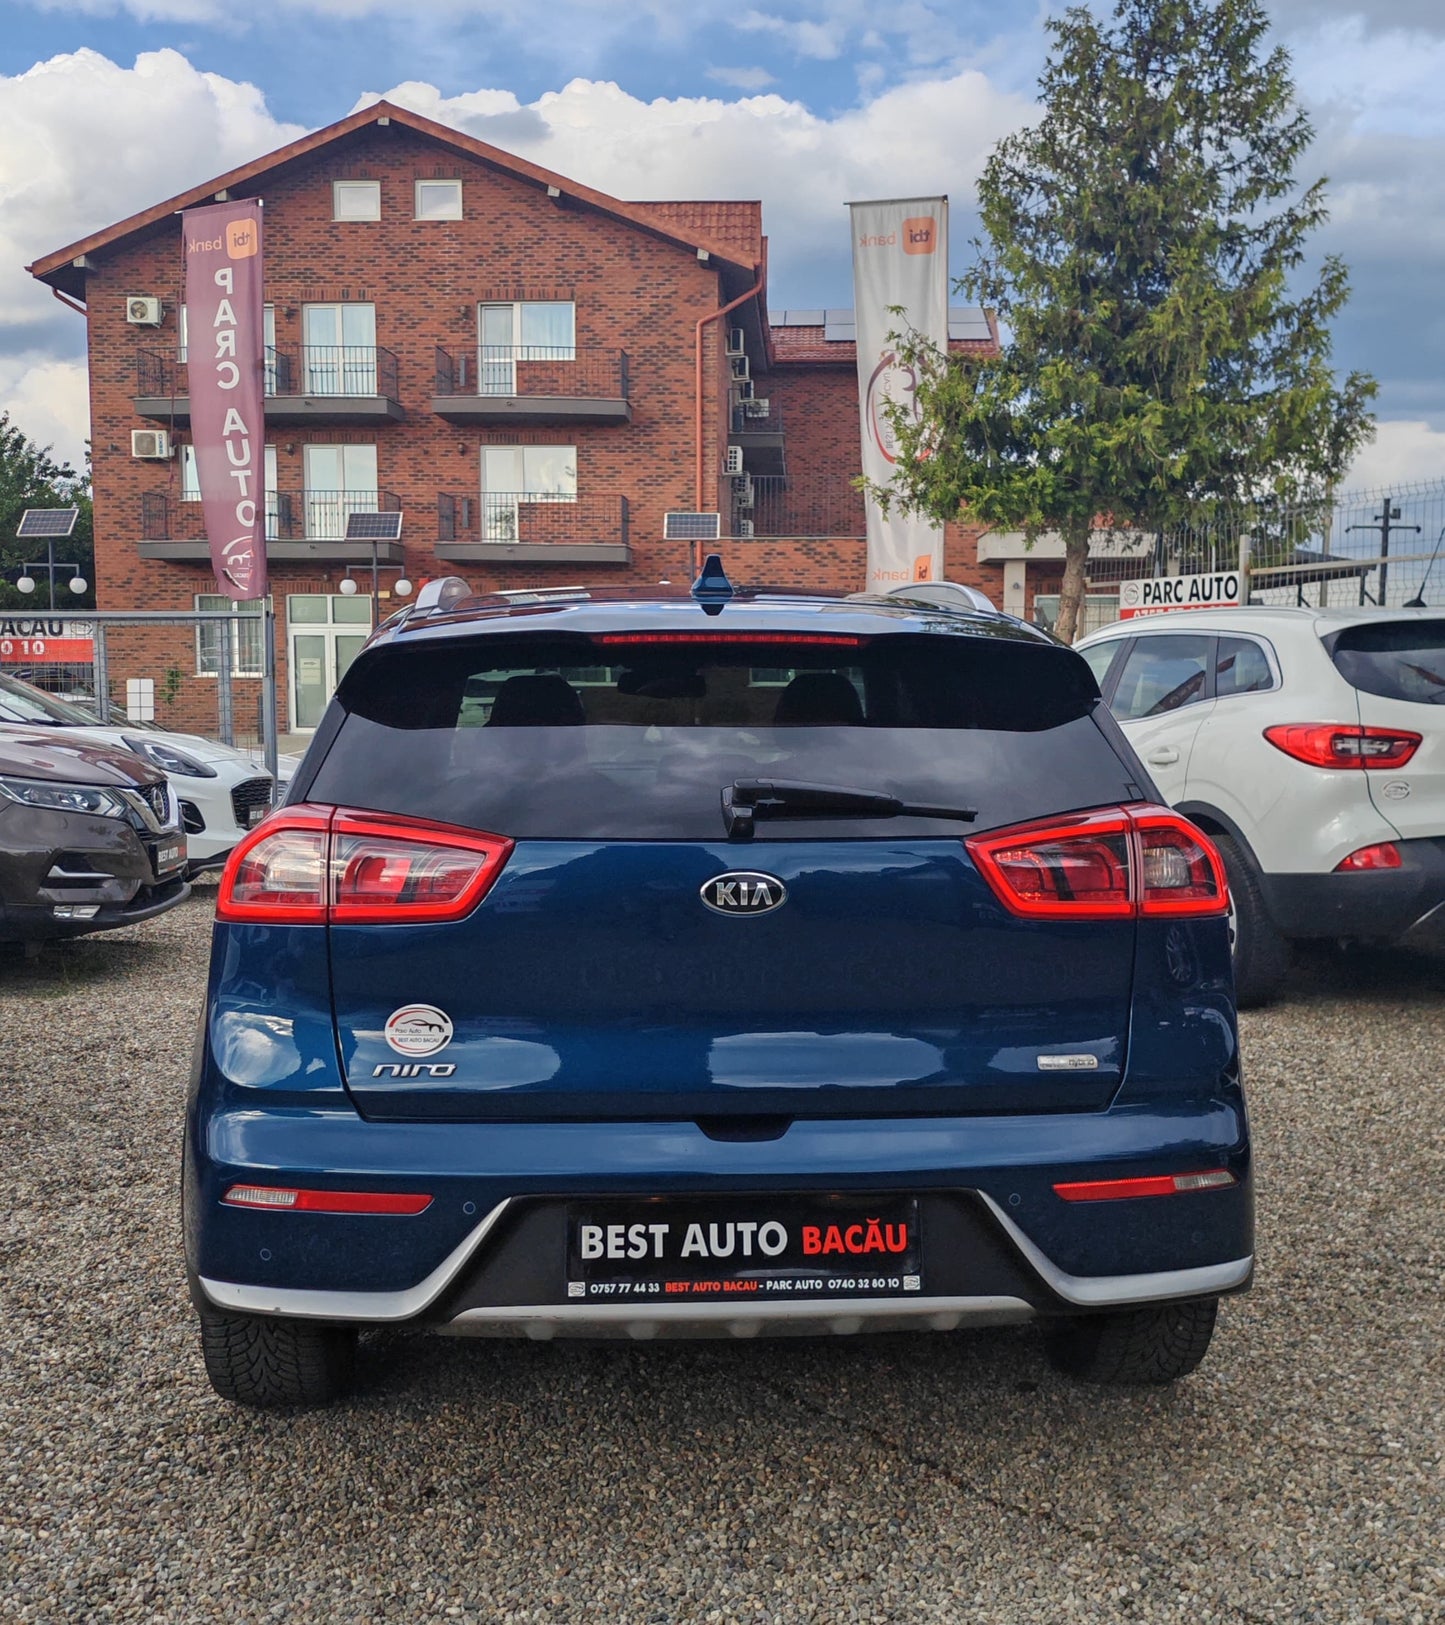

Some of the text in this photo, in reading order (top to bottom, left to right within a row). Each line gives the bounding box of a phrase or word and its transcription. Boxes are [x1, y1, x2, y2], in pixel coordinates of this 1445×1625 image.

[1143, 579, 1184, 605] PARC
[1188, 575, 1239, 602] AUTO
[20, 640, 45, 655] 10
[715, 881, 774, 906] KIA
[581, 1217, 908, 1260] BEST AUTO BACĂU
[590, 1283, 616, 1294] 0757
[618, 1283, 632, 1294] 77
[633, 1282, 647, 1293] 44
[648, 1282, 660, 1293] 33
[664, 1282, 691, 1293] BEST
[691, 1281, 721, 1292] AUTO
[766, 1279, 793, 1291] PARC
[794, 1279, 823, 1290] AUTO
[827, 1278, 855, 1289] 0740
[857, 1278, 870, 1289] 32
[871, 1278, 886, 1289] 80
[887, 1277, 900, 1288] 10
